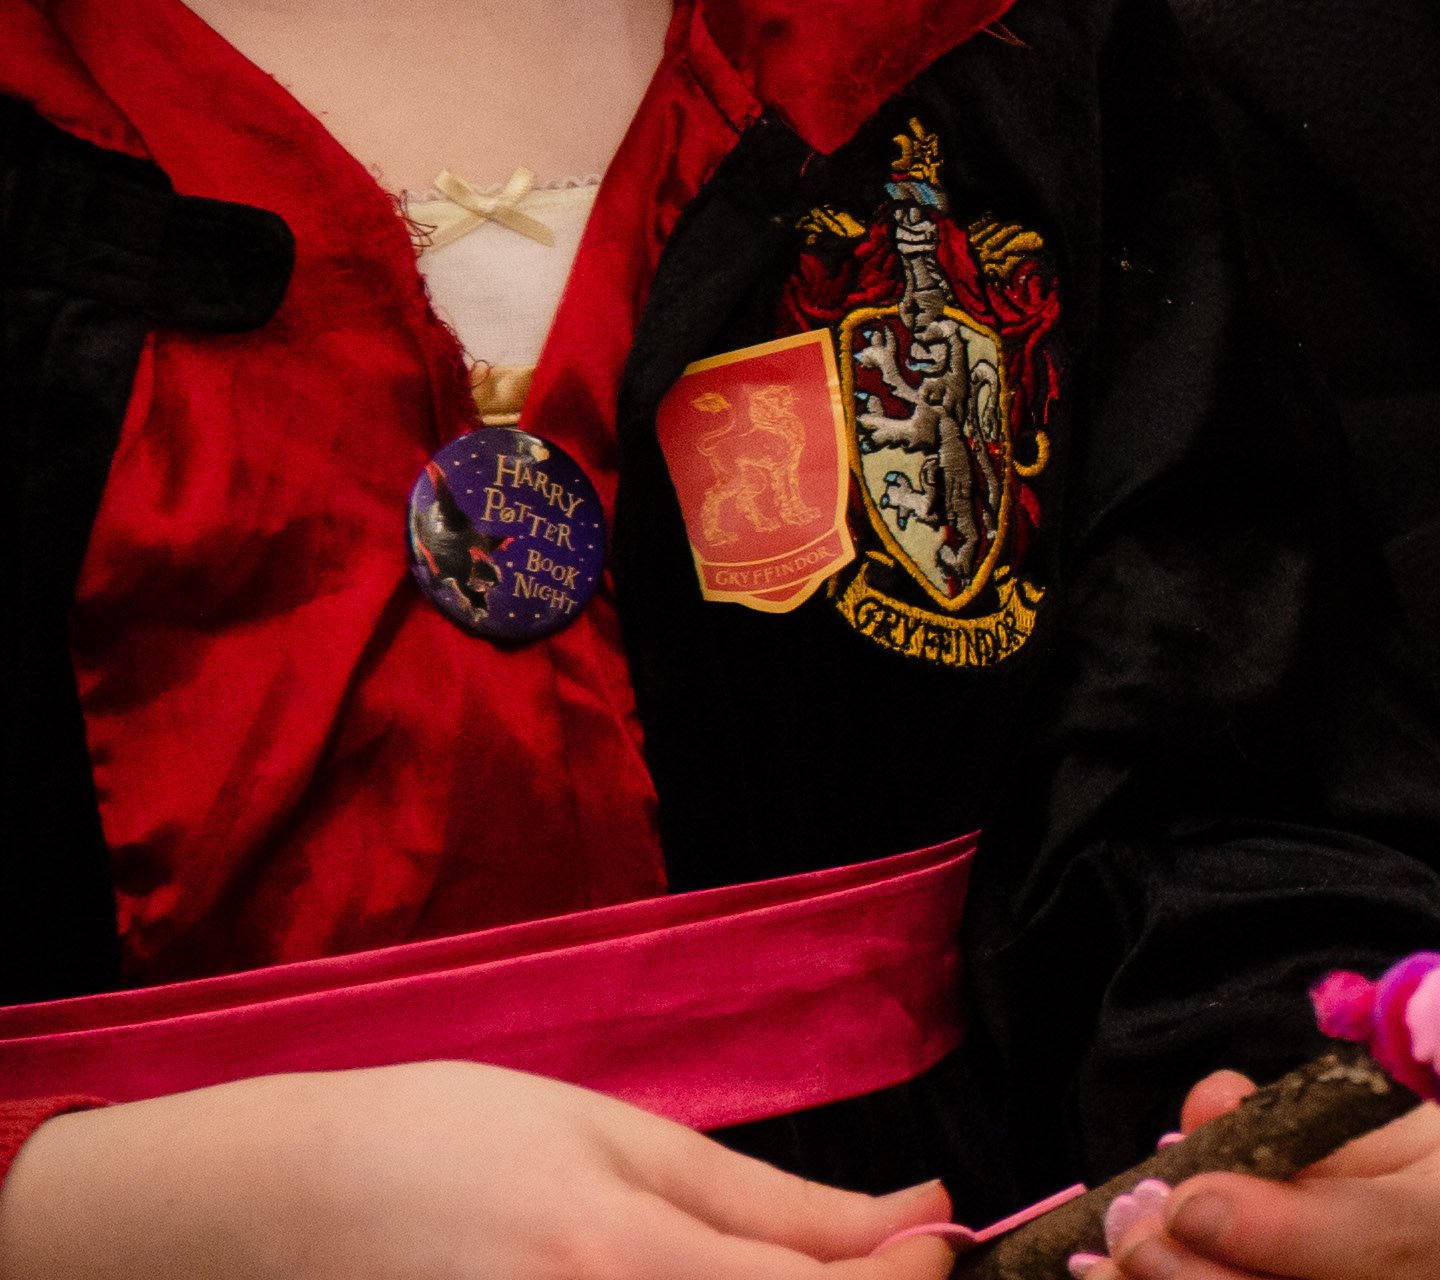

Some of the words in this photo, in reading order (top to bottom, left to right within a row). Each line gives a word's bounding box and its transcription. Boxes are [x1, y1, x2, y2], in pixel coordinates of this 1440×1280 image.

[493, 454, 585, 519] HARRY
[480, 487, 576, 552] POTTER
[512, 572, 578, 615] NIGHT
[525, 549, 581, 590] BOOK
[714, 545, 837, 589] GRYFFINDOR
[854, 596, 1031, 666] GRYFFINDOR
